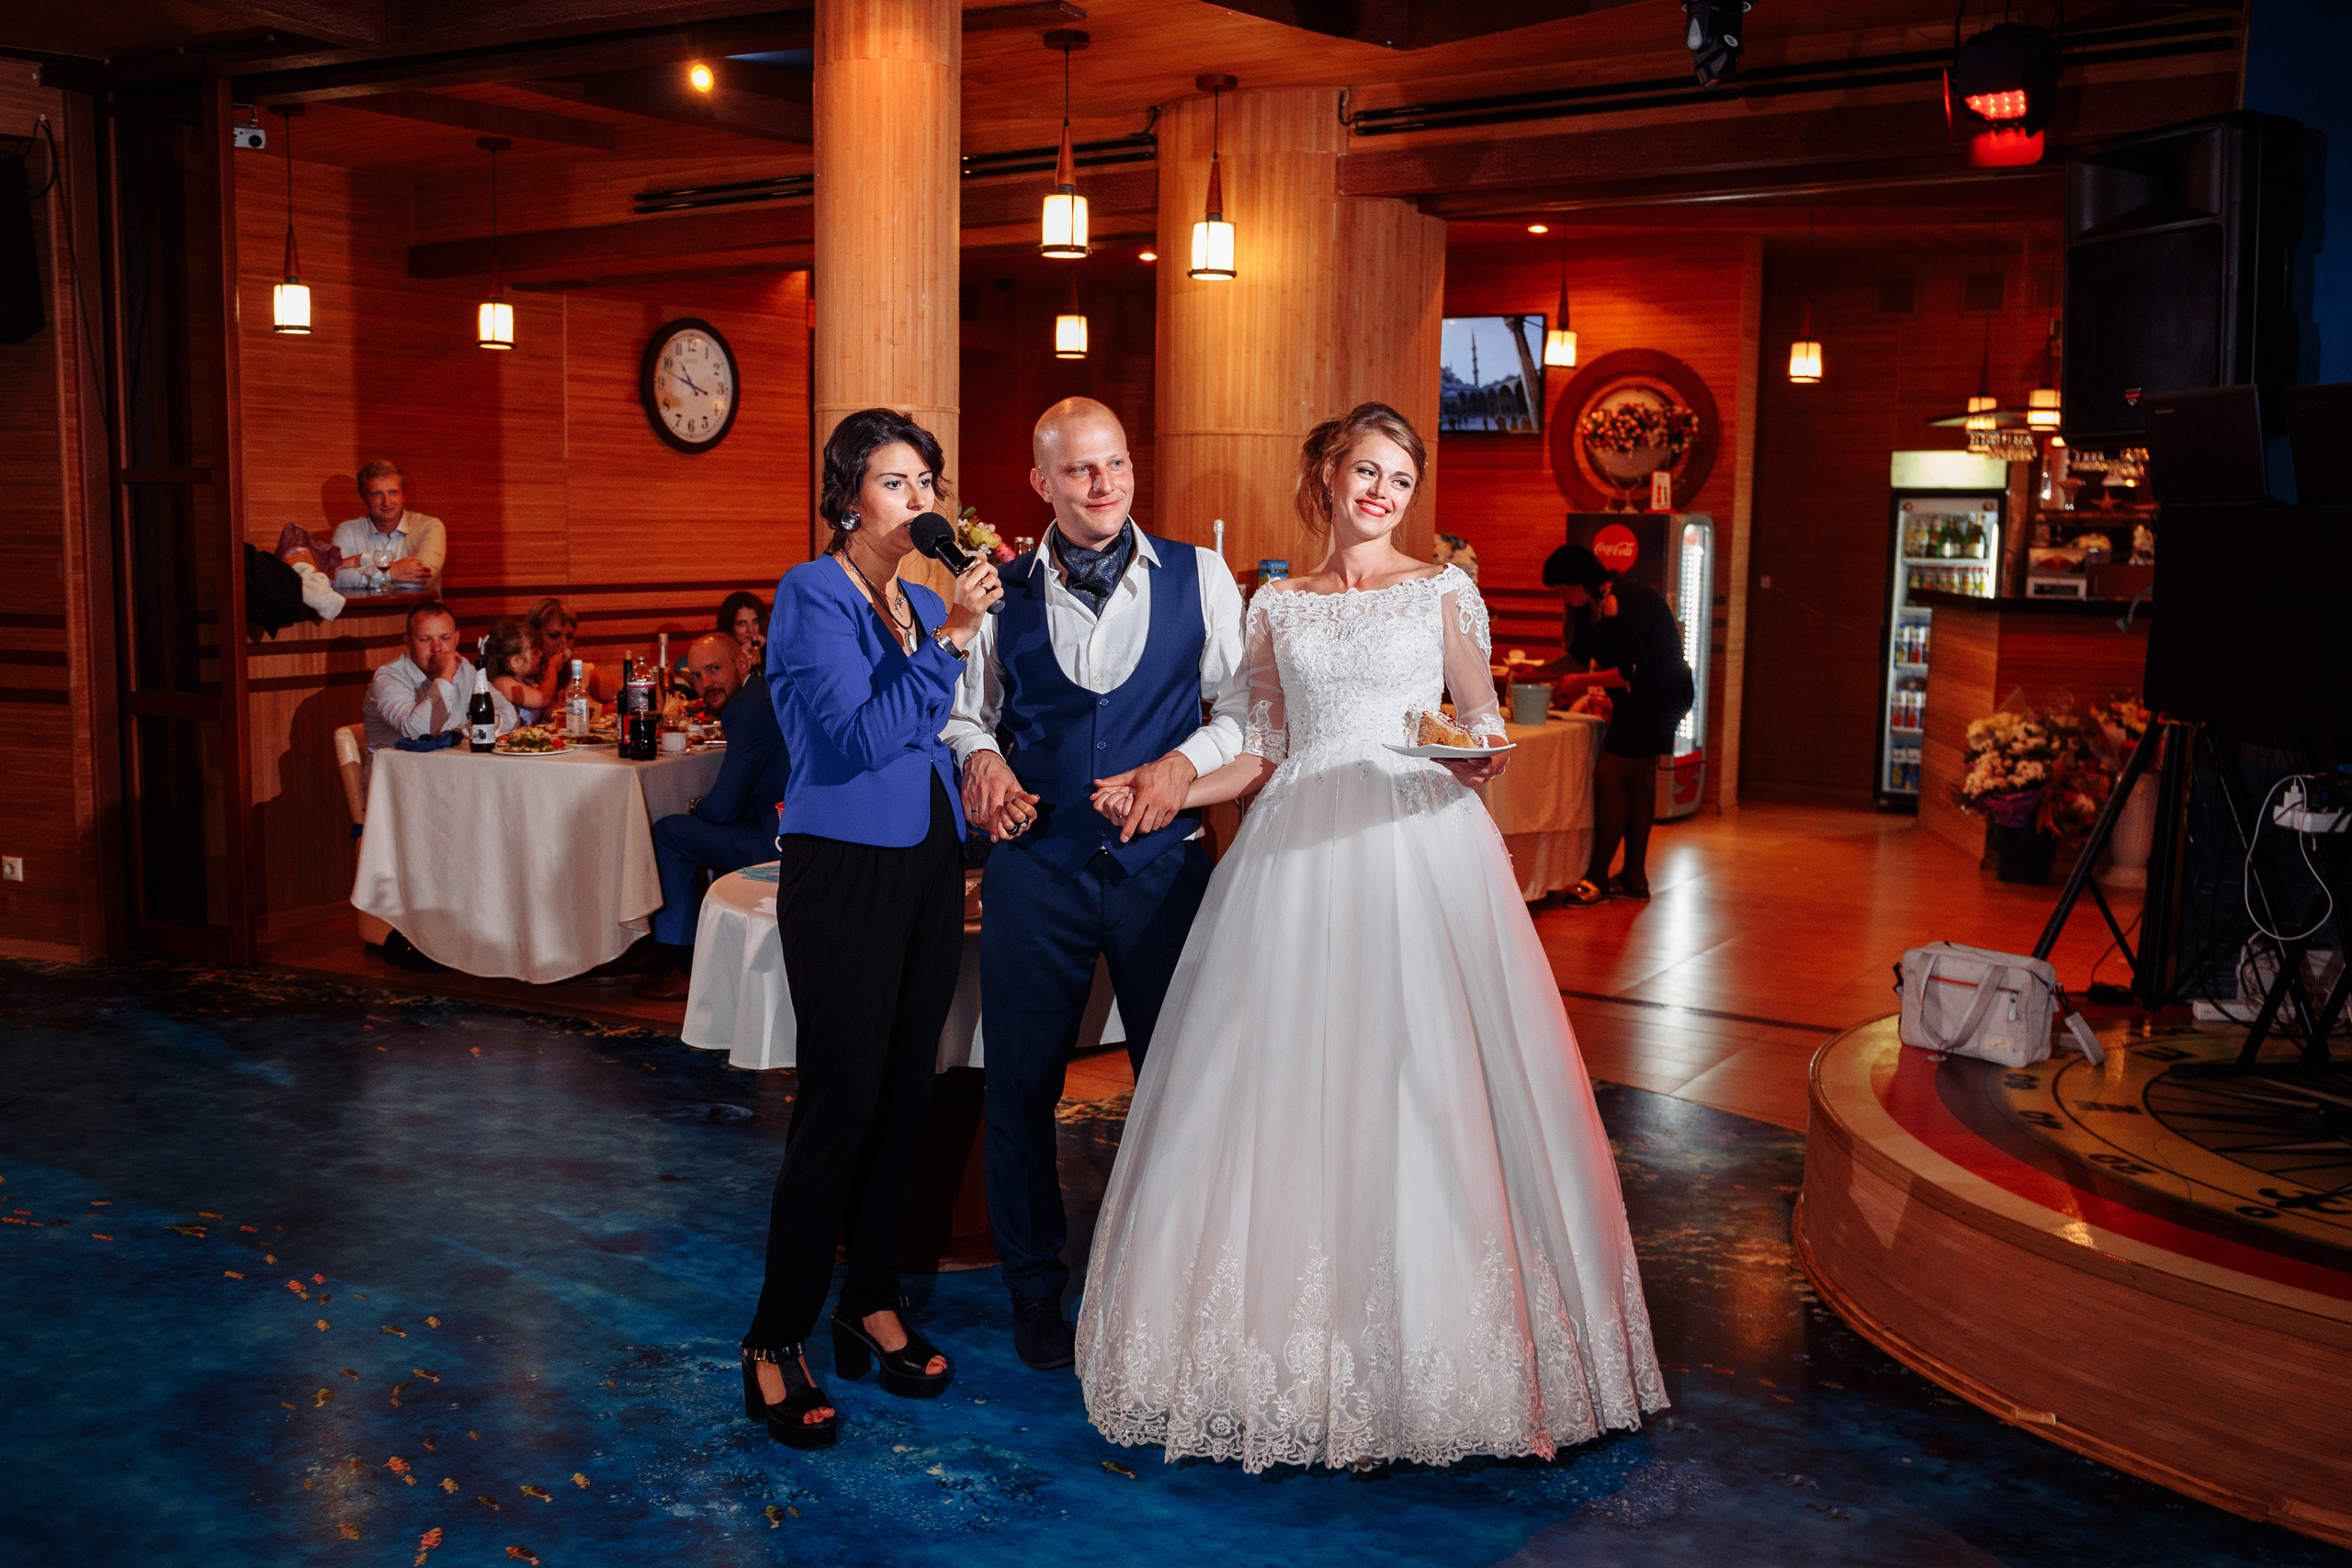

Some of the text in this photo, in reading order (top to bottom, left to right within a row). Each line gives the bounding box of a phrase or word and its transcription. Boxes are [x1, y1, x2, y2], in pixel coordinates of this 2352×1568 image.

[675, 343, 682, 356] 11
[687, 338, 697, 353] 12
[705, 346, 709, 359] 1
[663, 356, 673, 370] 10
[713, 362, 720, 376] 2
[658, 376, 665, 389] 9
[718, 382, 725, 396] 3
[662, 399, 670, 412] 8
[675, 413, 682, 427] 7
[687, 419, 695, 433] 6
[701, 416, 708, 429] 5
[2087, 1153, 2157, 1175] 20
